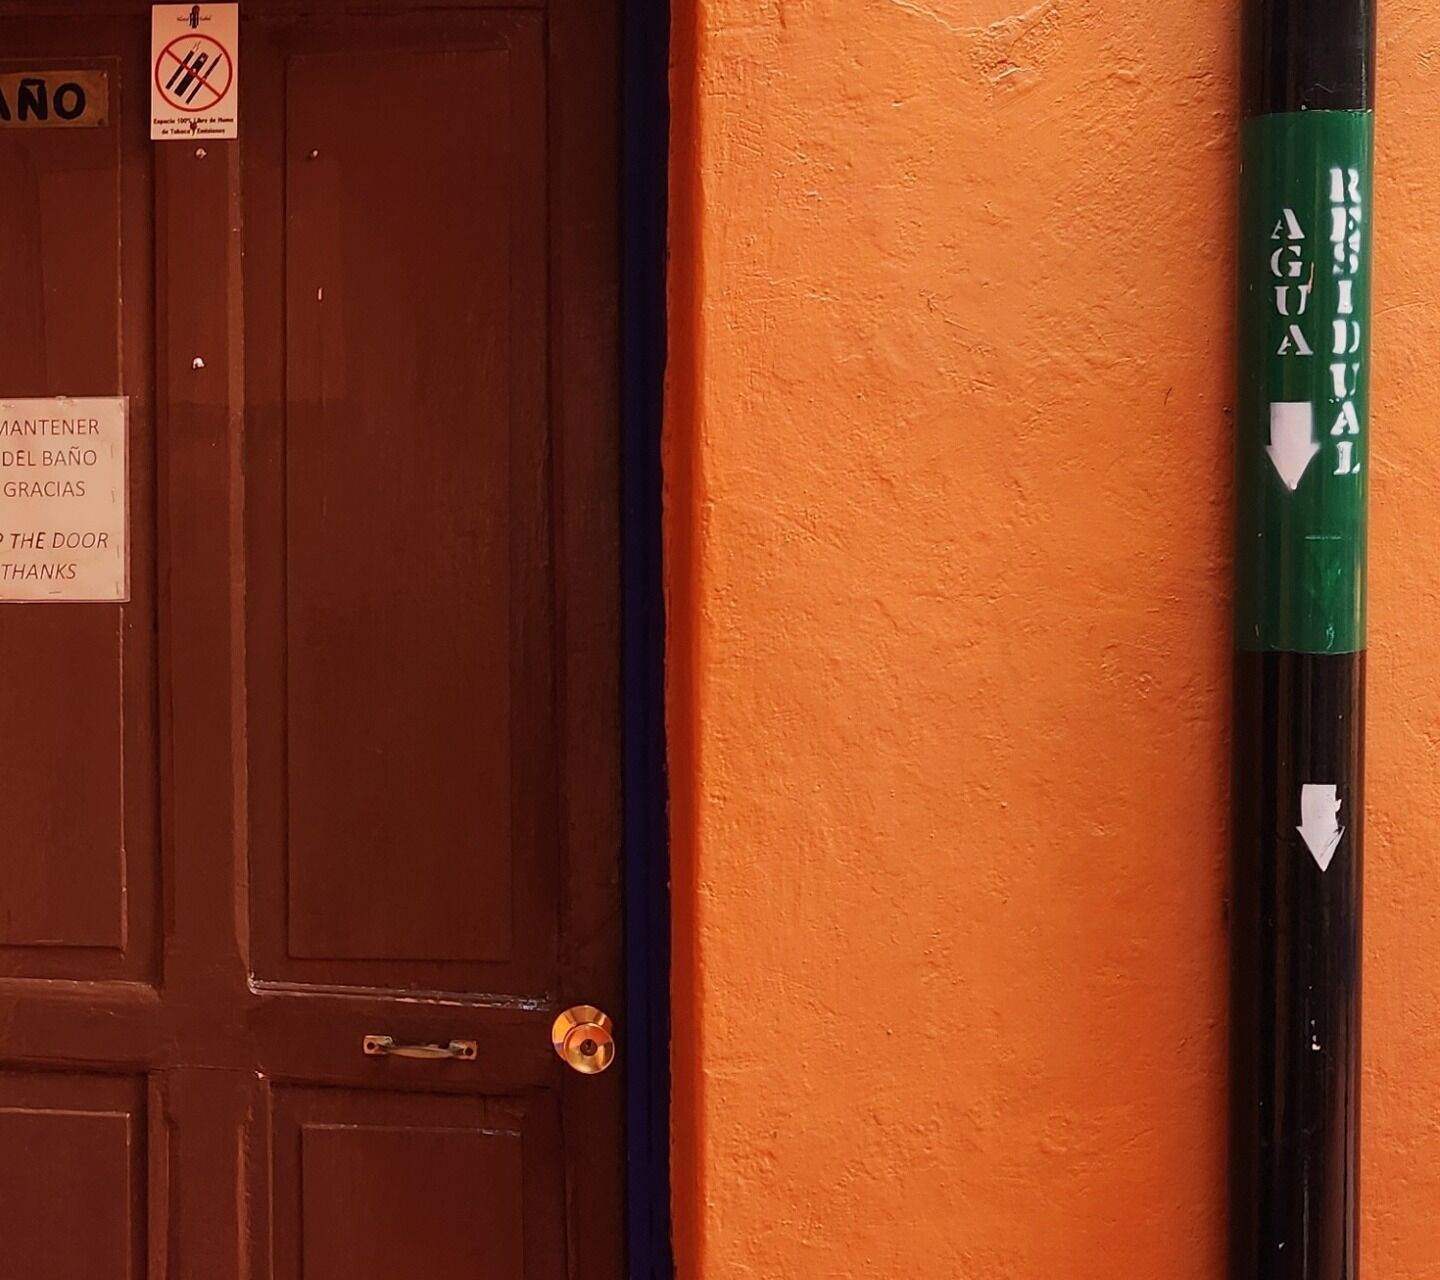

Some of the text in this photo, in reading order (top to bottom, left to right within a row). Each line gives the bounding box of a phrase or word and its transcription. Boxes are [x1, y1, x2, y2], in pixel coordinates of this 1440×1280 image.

[1270, 208, 1313, 356] AGUA
[1329, 167, 1362, 476] RESIDUAL
[2, 450, 36, 467] DEL
[42, 446, 98, 466] BAÑO
[3, 481, 86, 497] GRACIAS
[10, 532, 46, 549] THE
[52, 532, 109, 549] DOOR
[1, 563, 77, 580] THANKS
